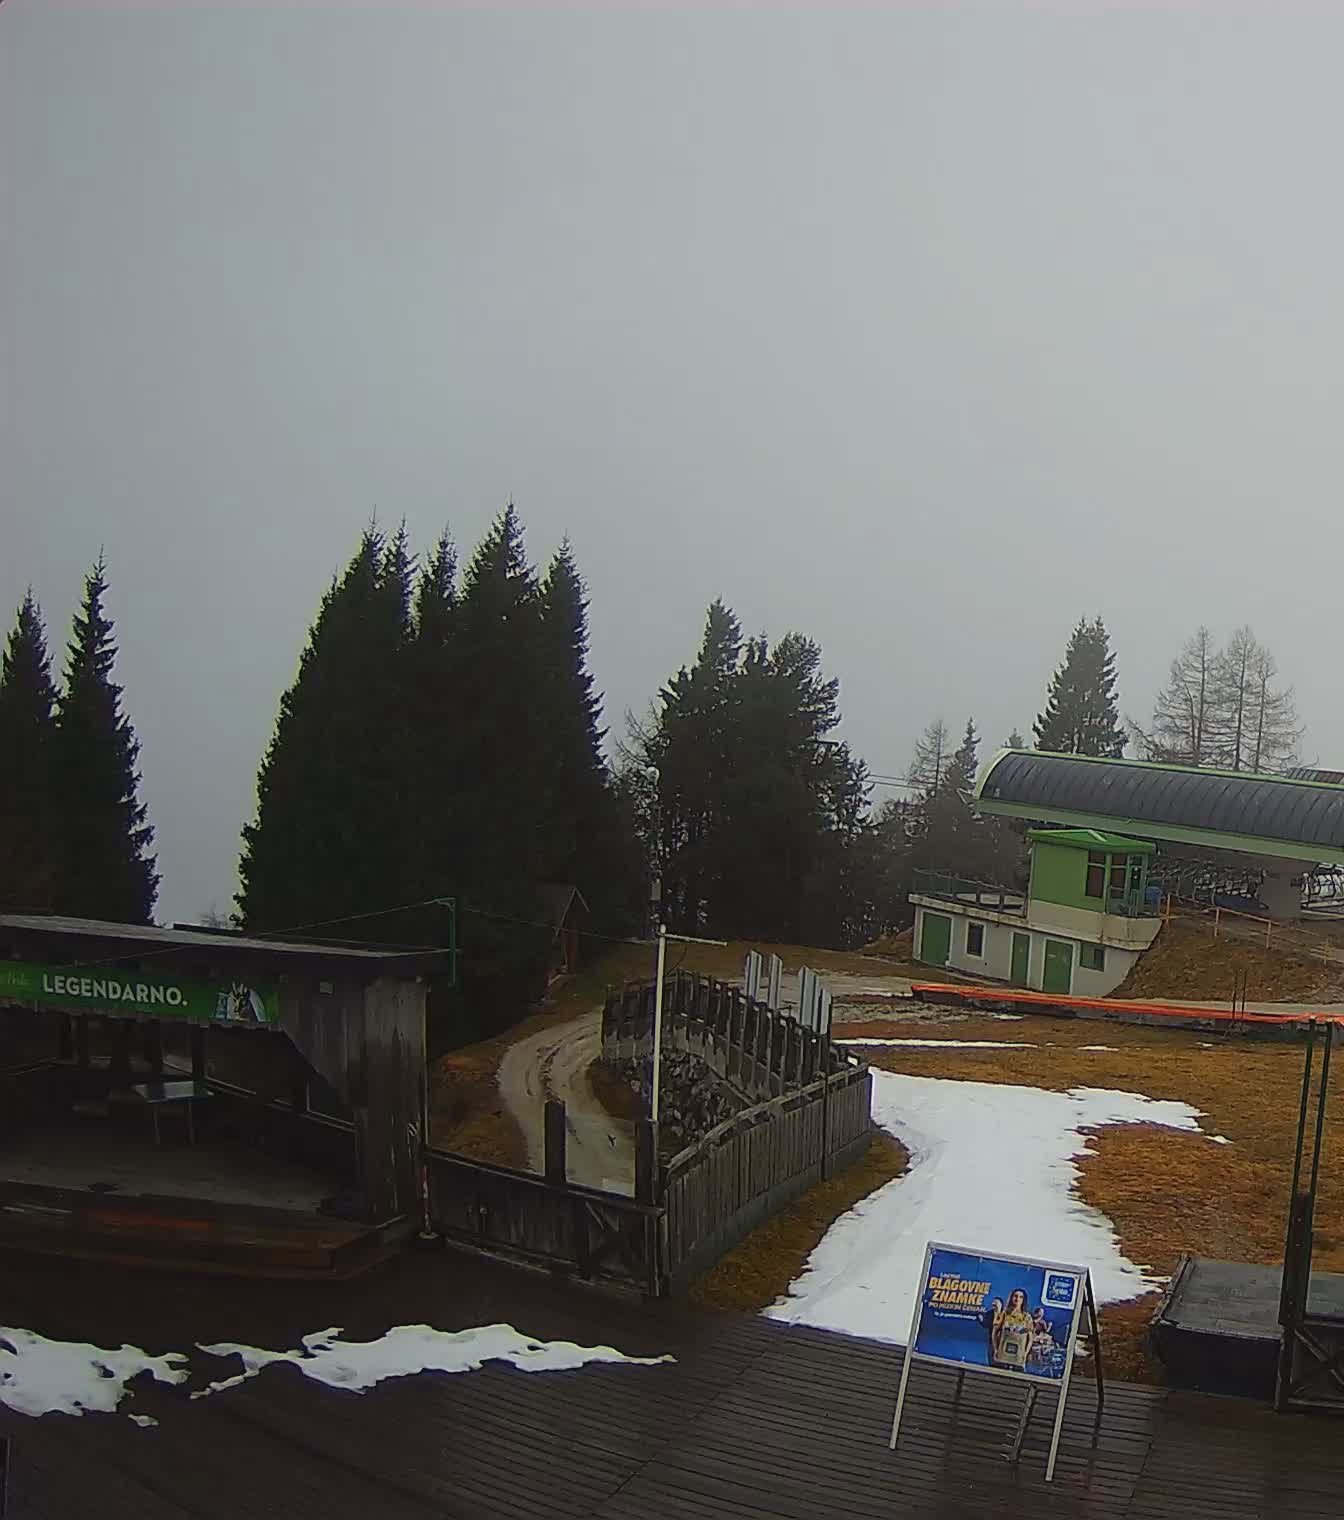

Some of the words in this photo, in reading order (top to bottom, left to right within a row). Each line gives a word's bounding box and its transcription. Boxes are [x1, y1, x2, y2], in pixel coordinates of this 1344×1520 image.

[42, 974, 188, 1005] LEGENDARNO.
[929, 1277, 992, 1294] BLAGOVNE
[932, 1290, 984, 1305] ZNAMKE
